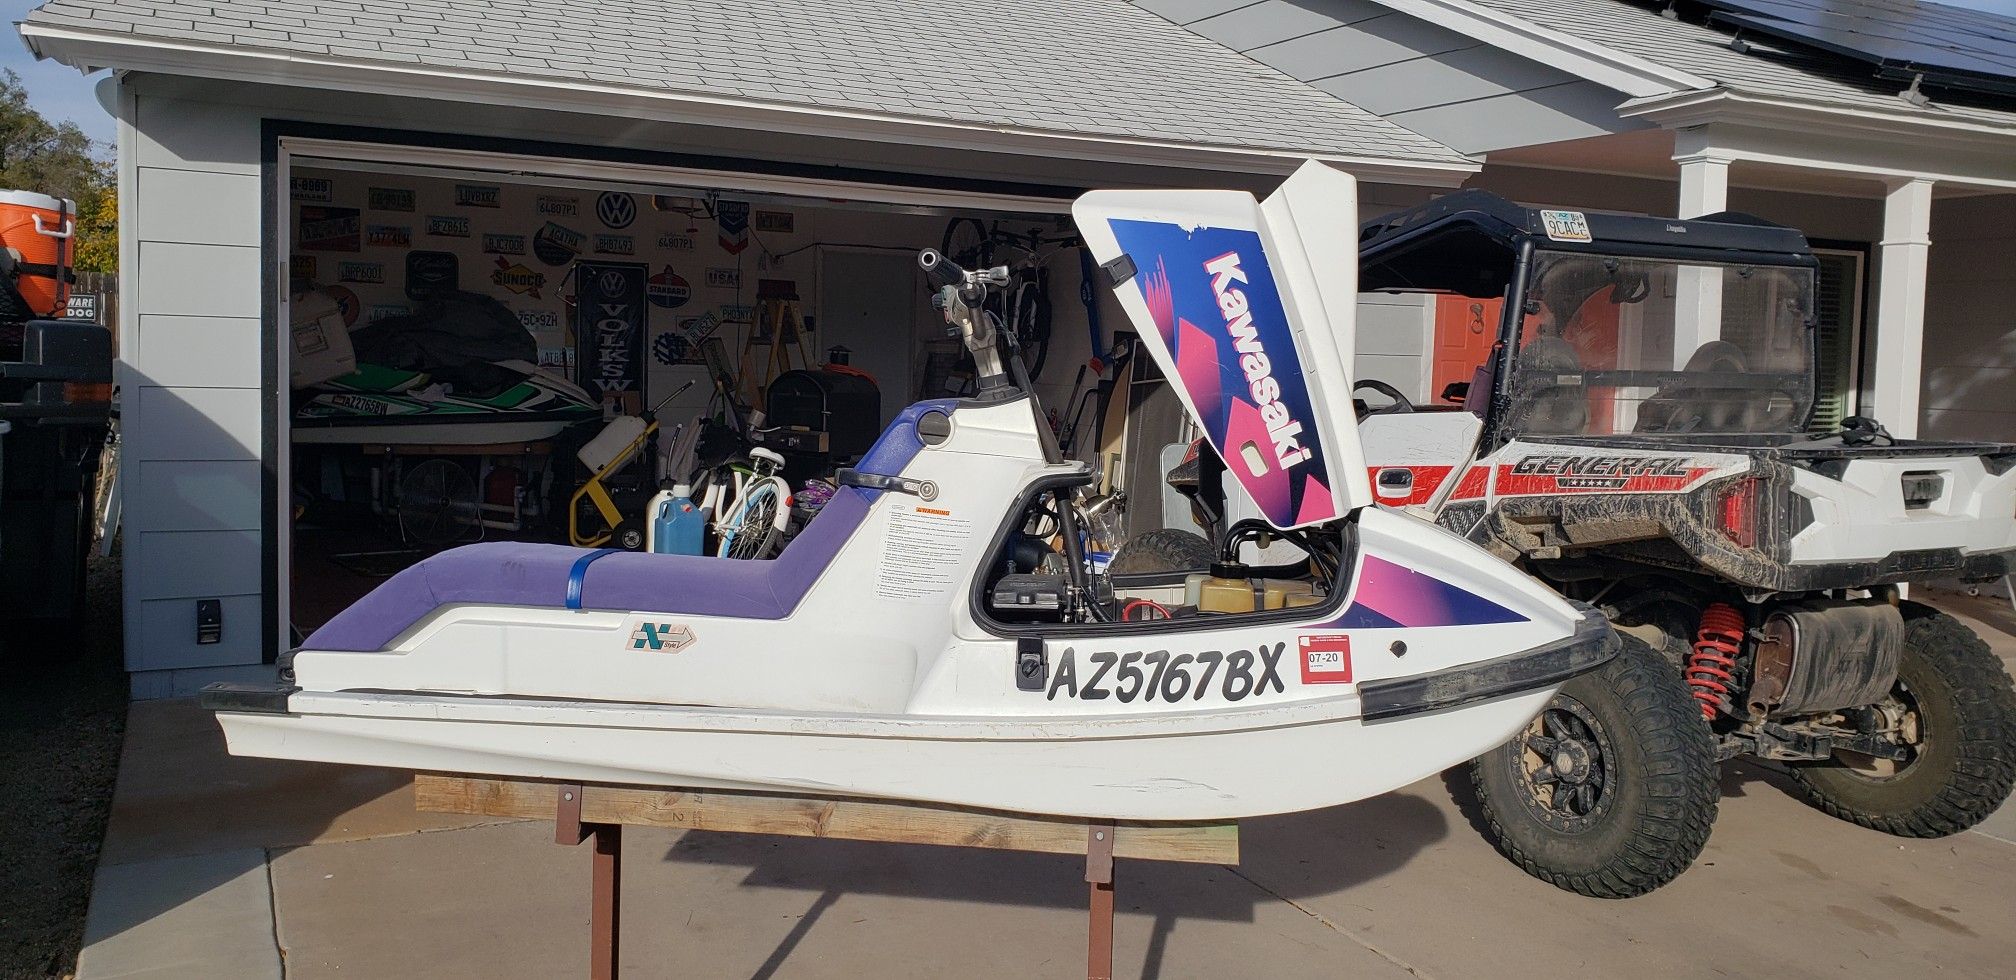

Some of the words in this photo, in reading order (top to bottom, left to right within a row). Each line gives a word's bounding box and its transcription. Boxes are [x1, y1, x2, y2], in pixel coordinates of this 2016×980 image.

[493, 268, 545, 287] SUNOCO
[649, 286, 687, 296] STANDARD
[67, 309, 93, 317] DOG
[1202, 251, 1312, 470] Kawasaki
[1510, 455, 1691, 477] GENERAL
[1309, 653, 1338, 662] 07-20
